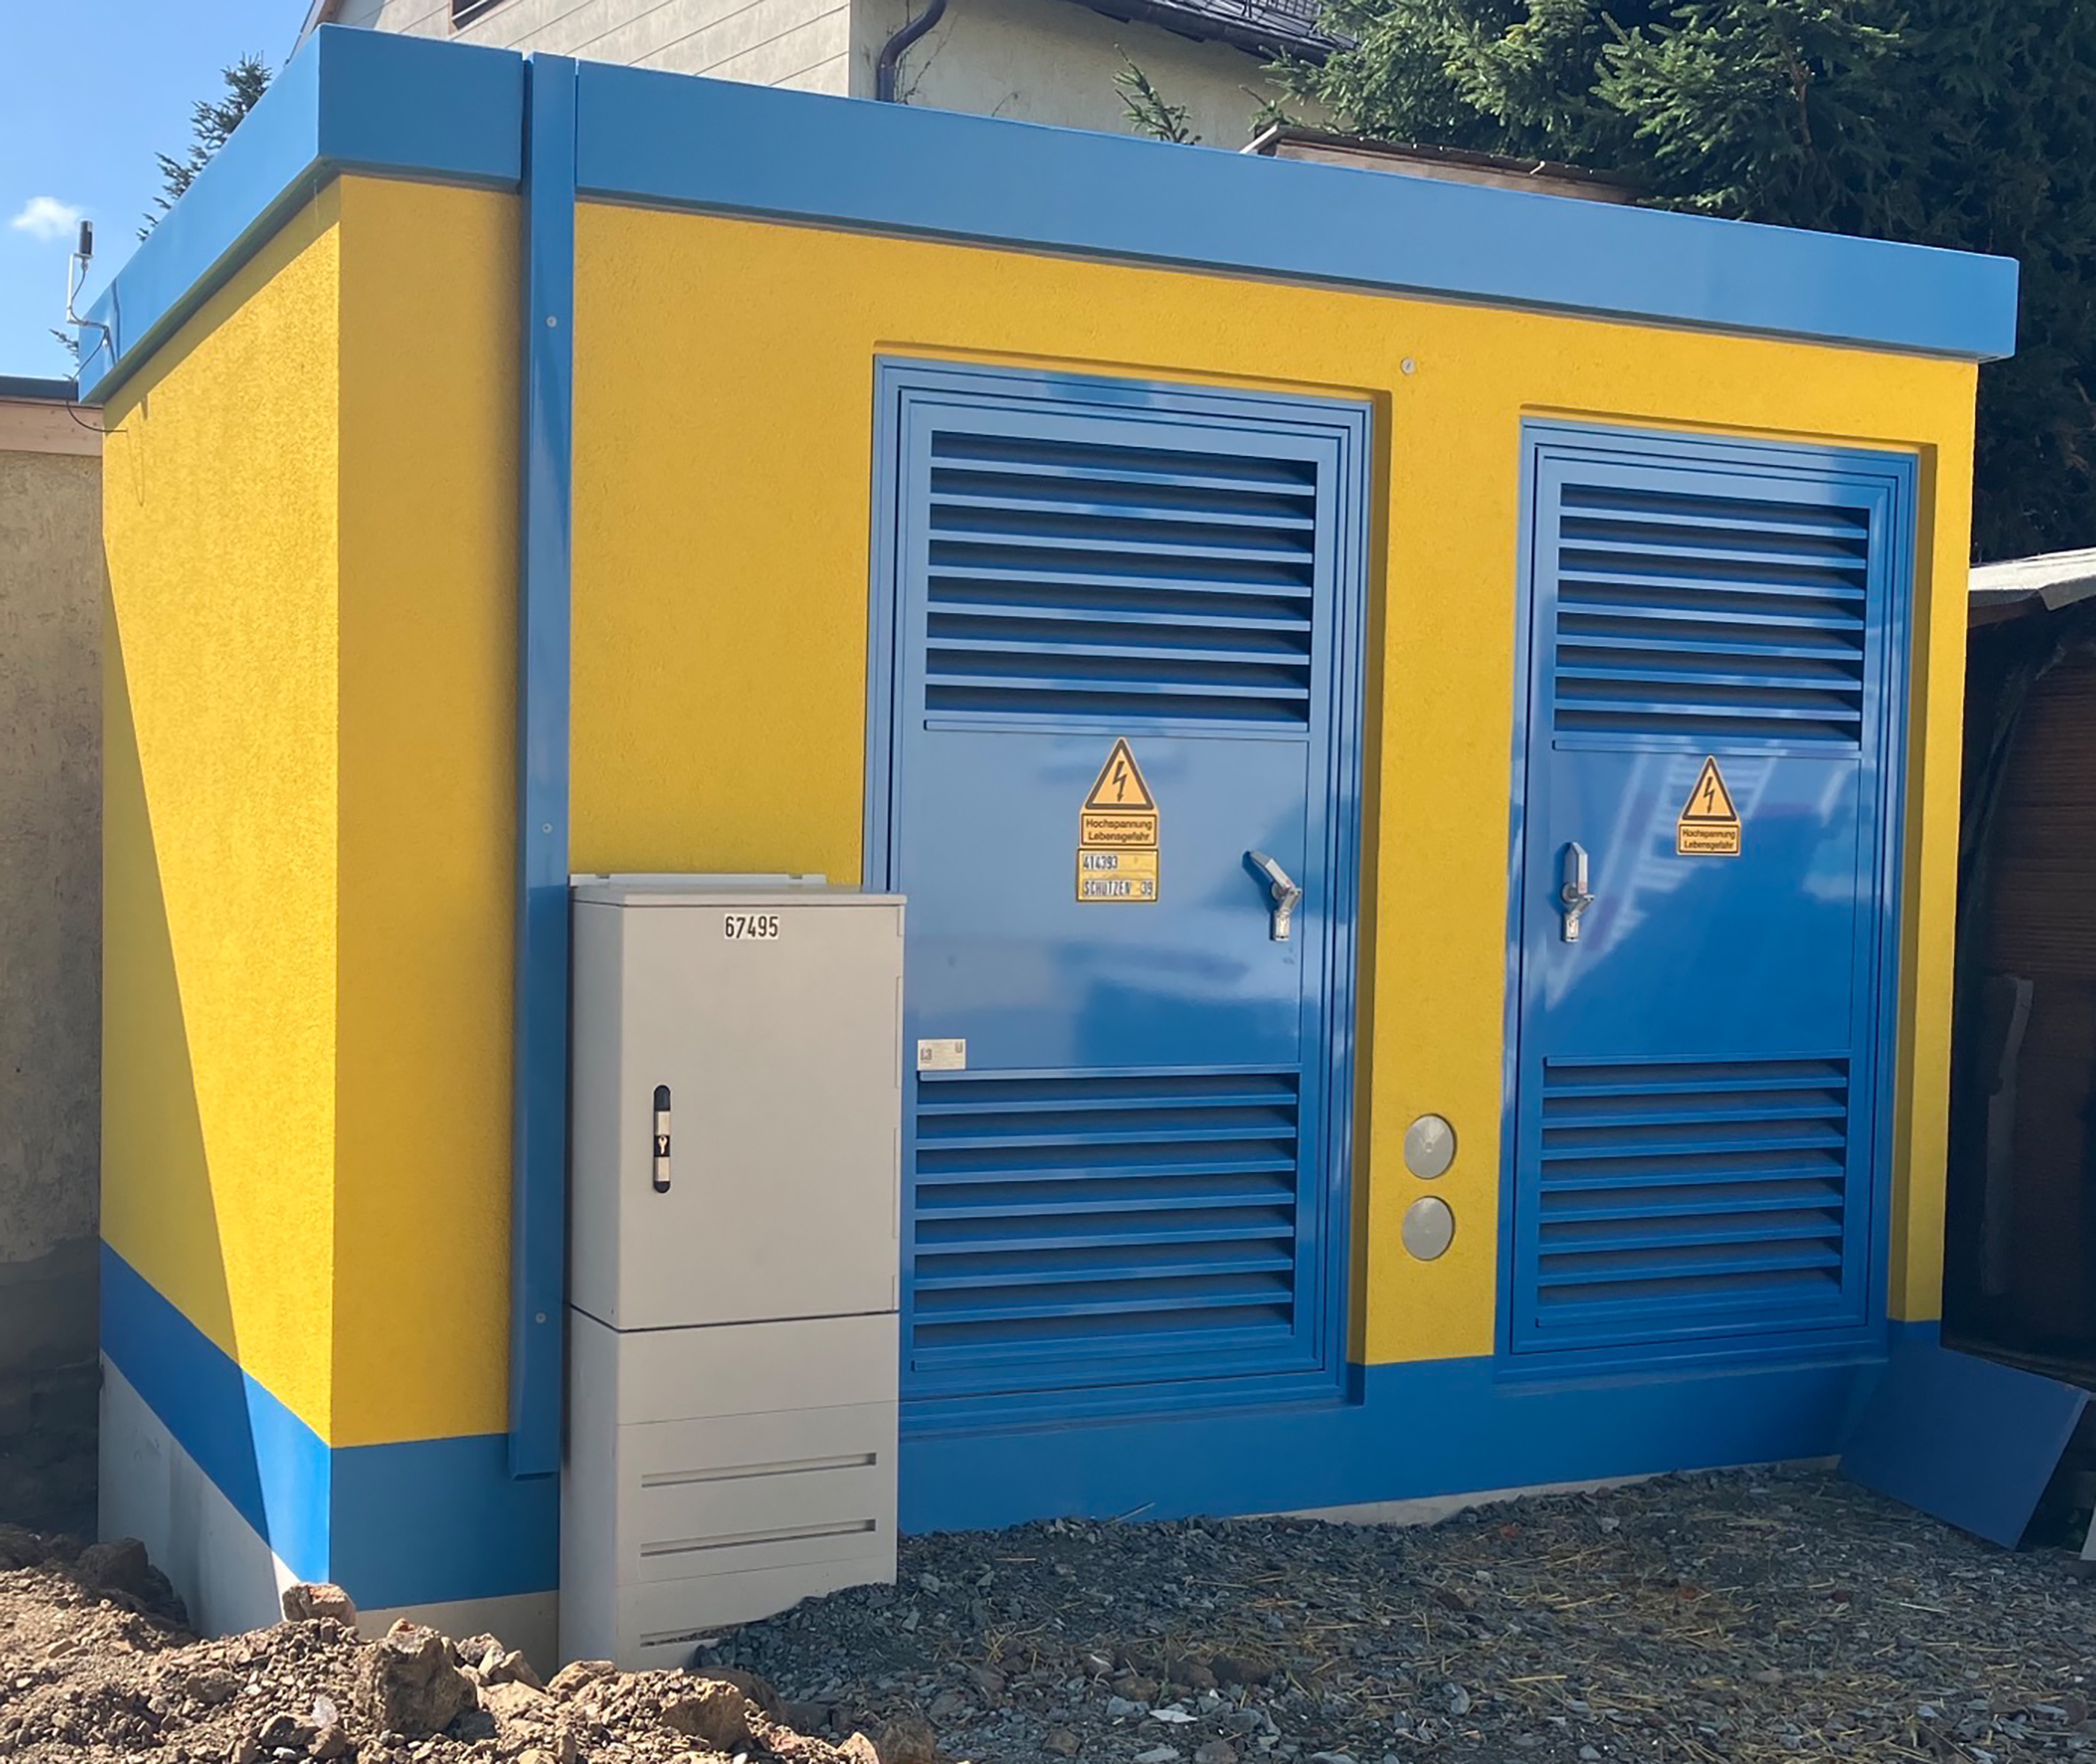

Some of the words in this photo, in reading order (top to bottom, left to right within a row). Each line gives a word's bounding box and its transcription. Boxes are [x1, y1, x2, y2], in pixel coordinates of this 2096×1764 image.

[1085, 818, 1153, 831] Hochspannung
[1088, 831, 1150, 842] Lebensgefahr
[1682, 829, 1736, 839] Hochspannung
[1684, 840, 1735, 850] Lebensgefahr
[725, 915, 779, 939] 67495
